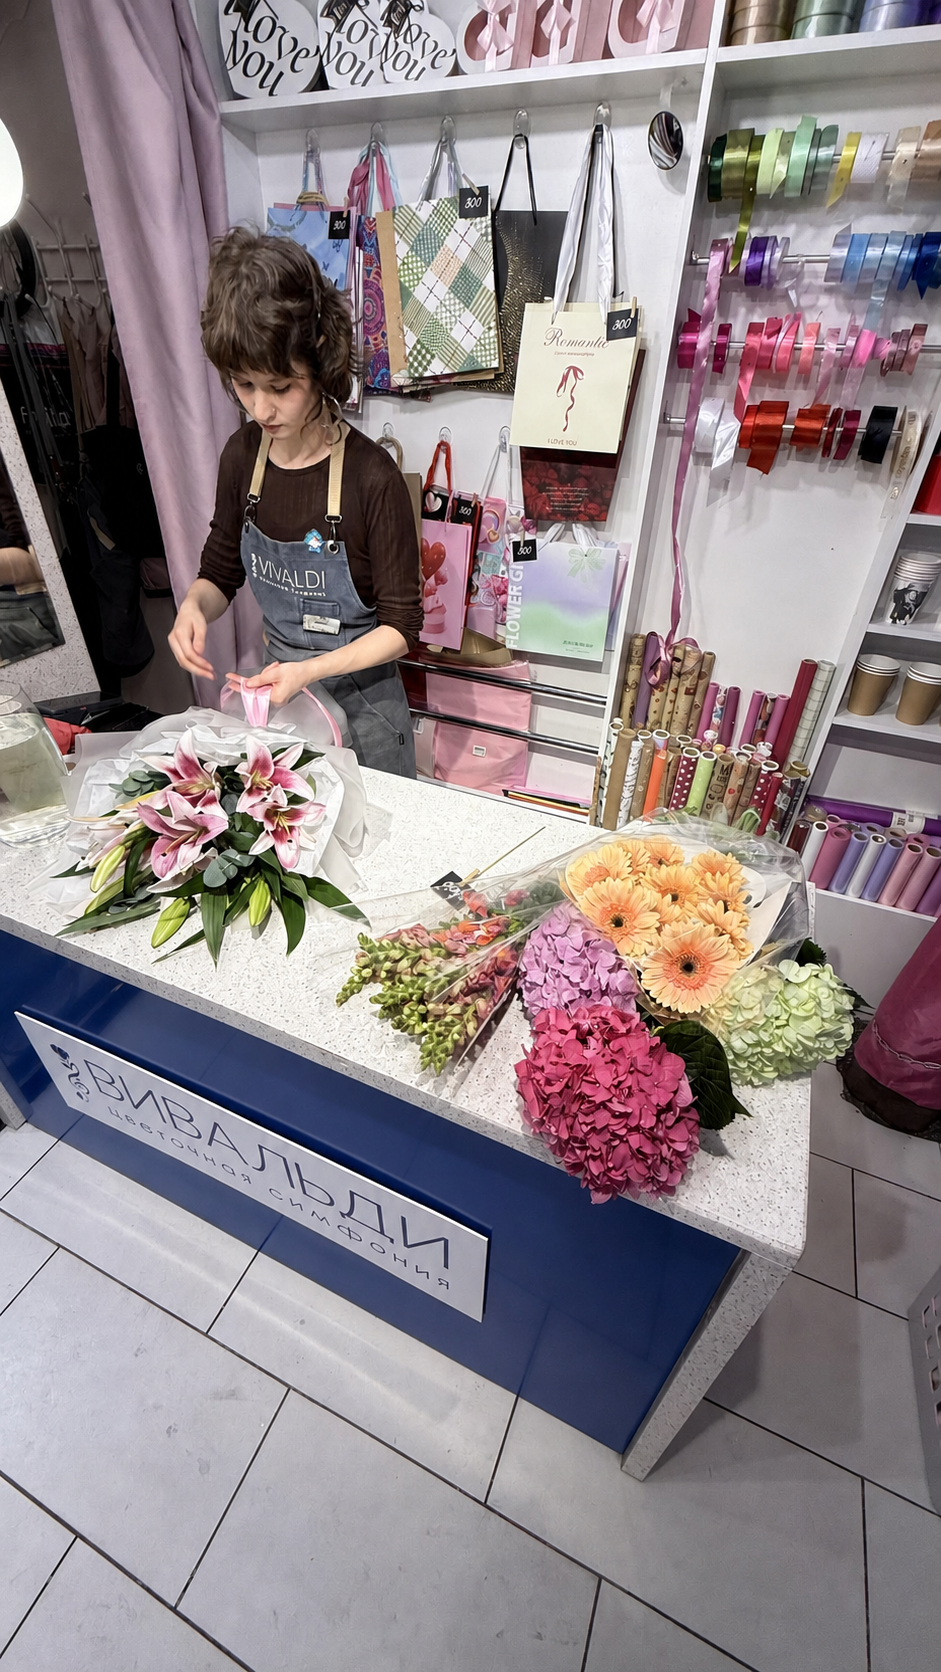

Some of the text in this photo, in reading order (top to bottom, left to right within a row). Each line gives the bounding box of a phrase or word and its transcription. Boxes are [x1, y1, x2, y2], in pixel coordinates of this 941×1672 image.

[465, 196, 483, 209] 300
[543, 327, 610, 349] Romantic
[611, 317, 632, 331] 300
[550, 438, 565, 446] LOVE
[258, 555, 327, 590] VIVALDI
[505, 585, 523, 649] FLOWER
[83, 1058, 449, 1270] ВИВАЛЬДИ
[106, 1105, 449, 1290] цветочная симфония
